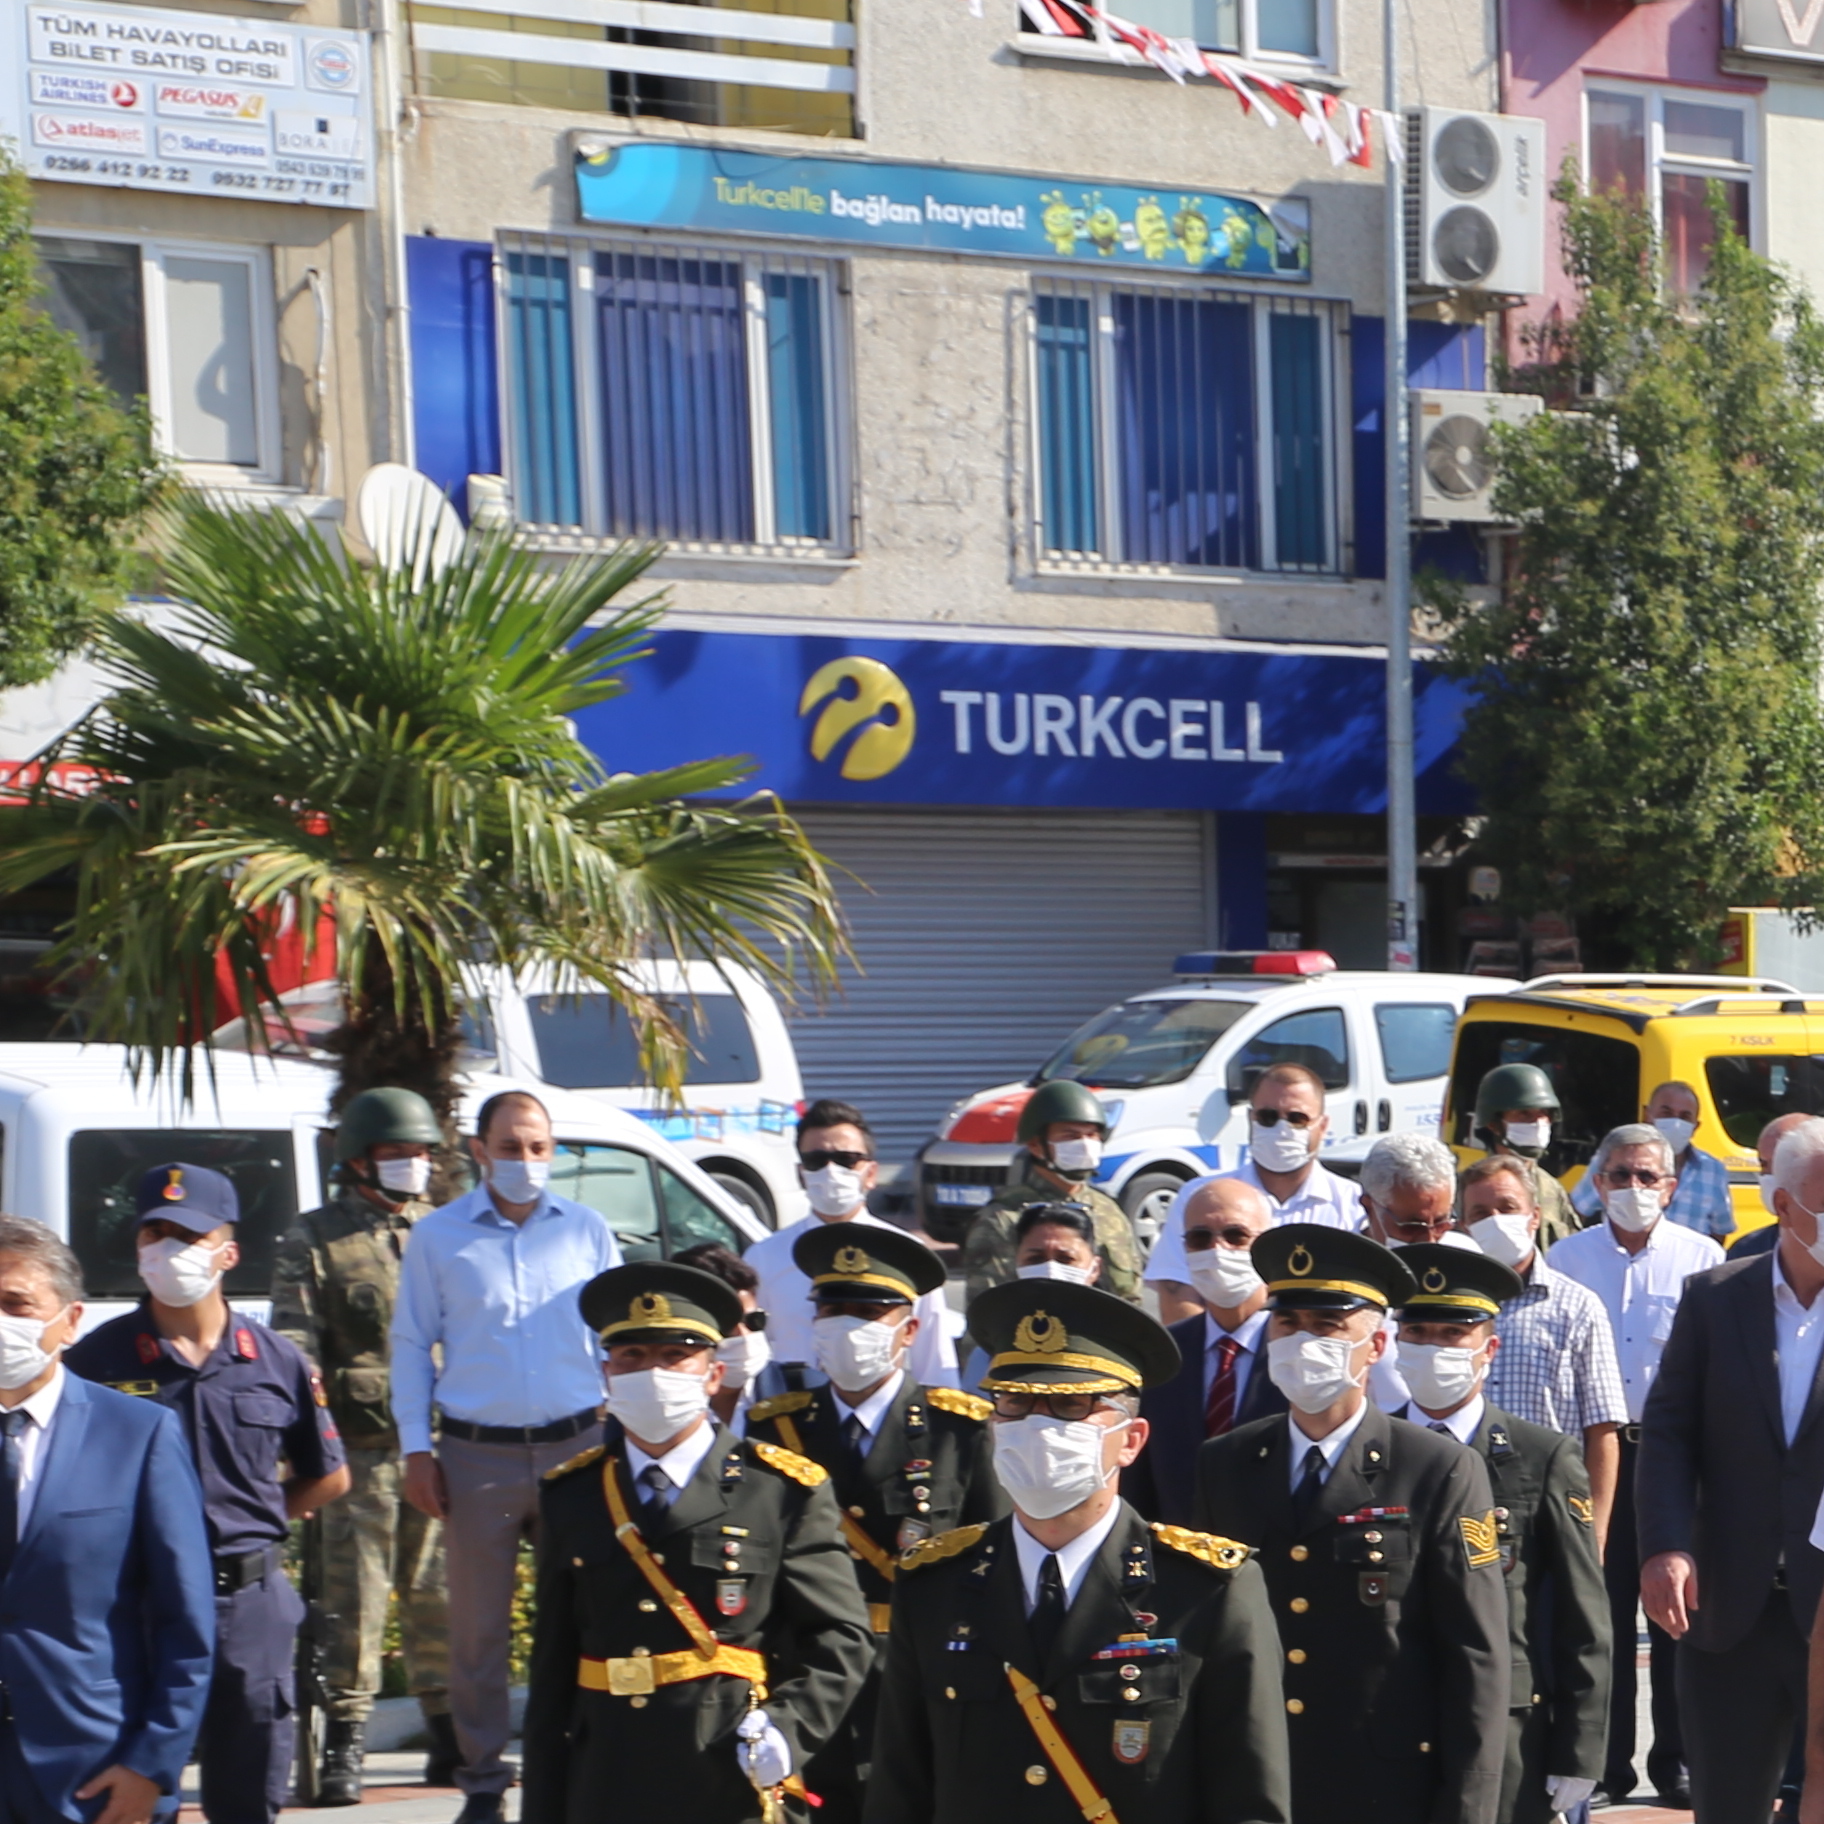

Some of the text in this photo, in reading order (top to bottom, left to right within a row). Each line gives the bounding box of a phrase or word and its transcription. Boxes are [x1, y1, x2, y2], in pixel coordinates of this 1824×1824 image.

[36, 14, 287, 57] TÜM HAVAYOLLARI
[130, 49, 206, 75] SATIŞ
[39, 74, 107, 90] TURKISH
[39, 88, 108, 103] AIRLINES
[159, 86, 239, 108] PEGASUS
[66, 122, 142, 142] atlasjet
[180, 135, 266, 157] SunExpress
[830, 189, 923, 227] bağlan
[925, 195, 1026, 231] hayata!
[940, 690, 1284, 764] TURKCELL
